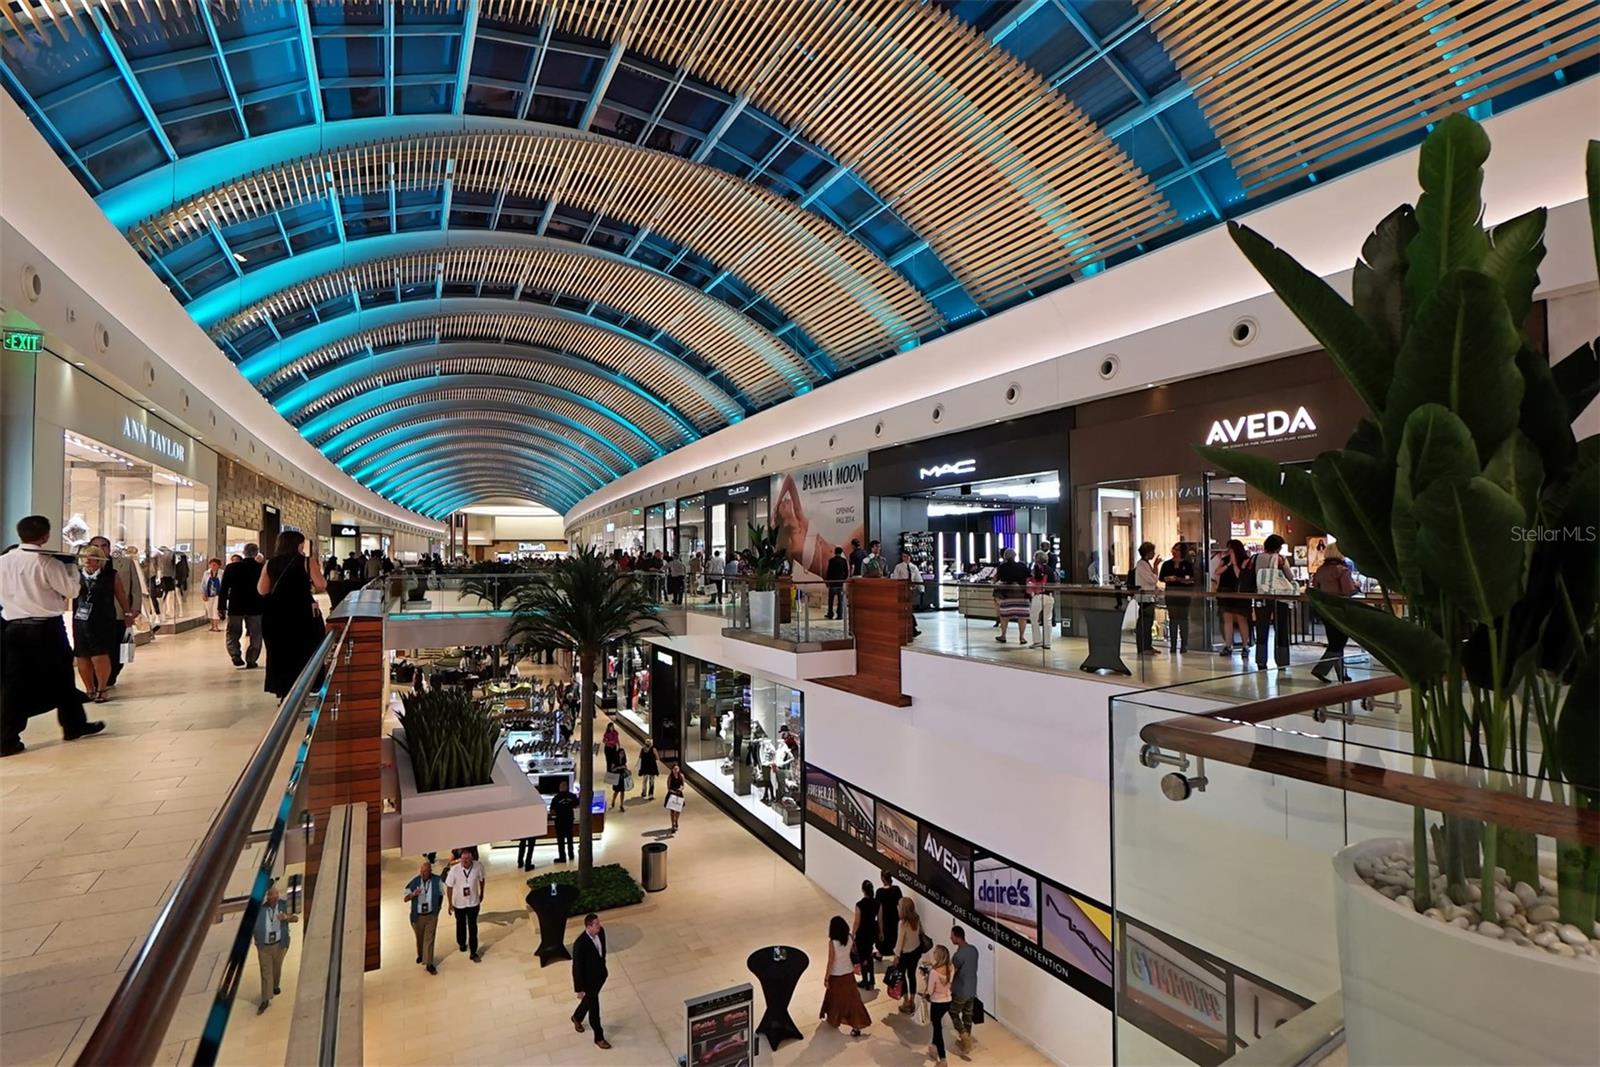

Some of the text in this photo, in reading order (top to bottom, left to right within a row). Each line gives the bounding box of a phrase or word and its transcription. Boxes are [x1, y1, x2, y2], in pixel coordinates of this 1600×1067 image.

[11, 334, 38, 350] EXIT
[123, 416, 185, 462] ANN TAYLOR
[1205, 405, 1317, 446] AVEDA
[802, 469, 832, 491] BANANA
[835, 462, 865, 485] MOON
[924, 832, 969, 889] AVEDA
[978, 878, 1031, 907] claire's
[968, 912, 981, 926] THE
[982, 920, 1010, 942] CENTER
[1011, 937, 1022, 948] OF
[1023, 945, 1069, 977] ATTENTION
